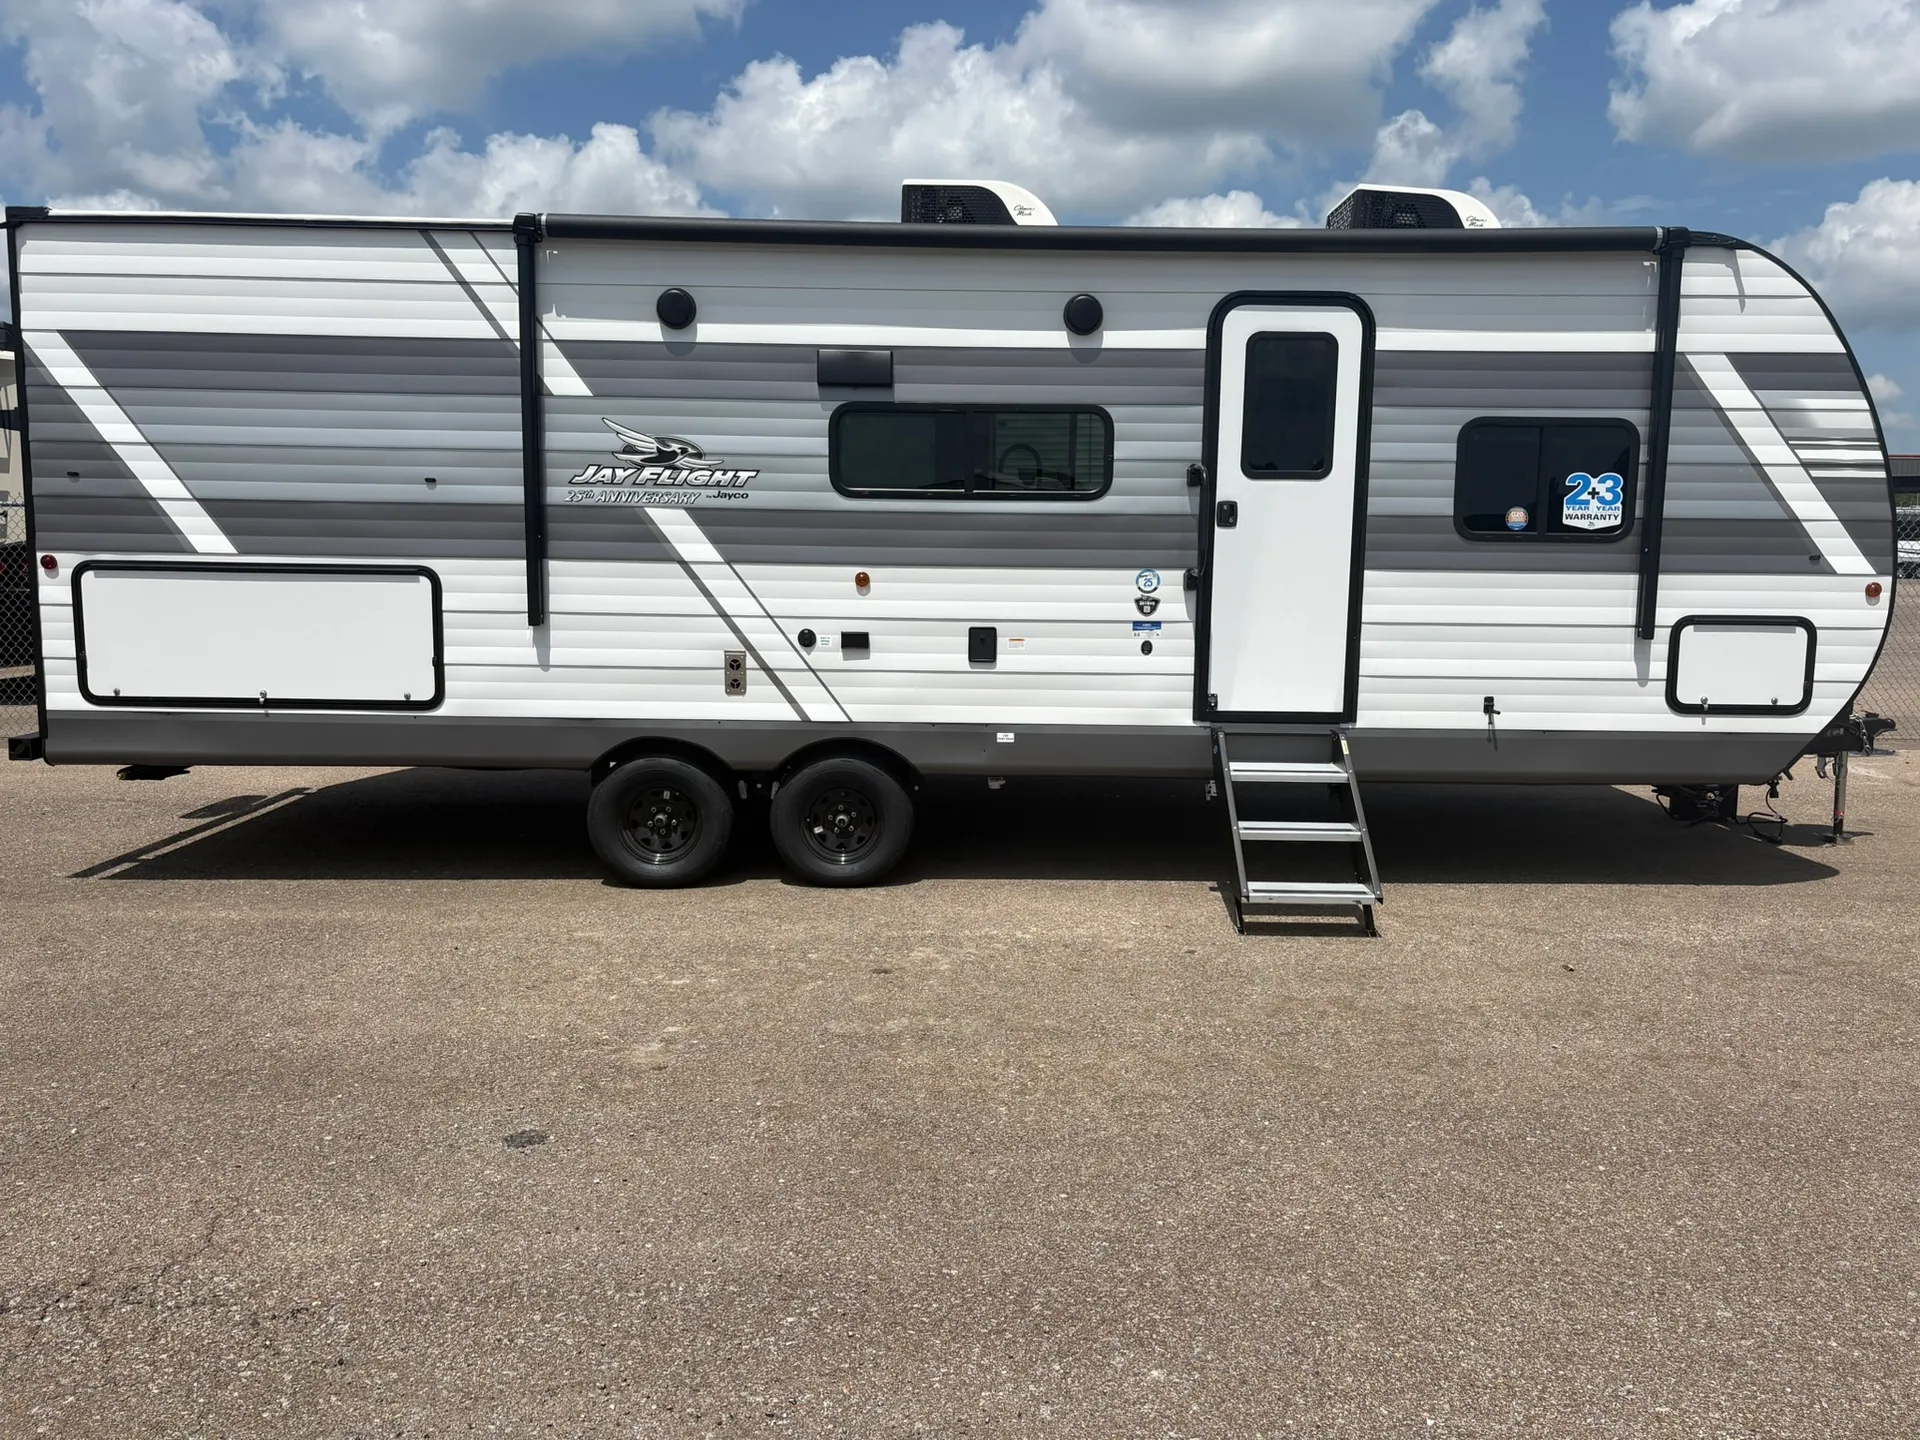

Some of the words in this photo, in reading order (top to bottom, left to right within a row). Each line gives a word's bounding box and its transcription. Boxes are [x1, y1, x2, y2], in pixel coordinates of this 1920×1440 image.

[568, 464, 639, 485] JAY
[632, 465, 760, 488] FLIGHT
[564, 489, 595, 502] 25th
[594, 490, 702, 504] ANNIVERSARY
[713, 490, 749, 500] Jayco
